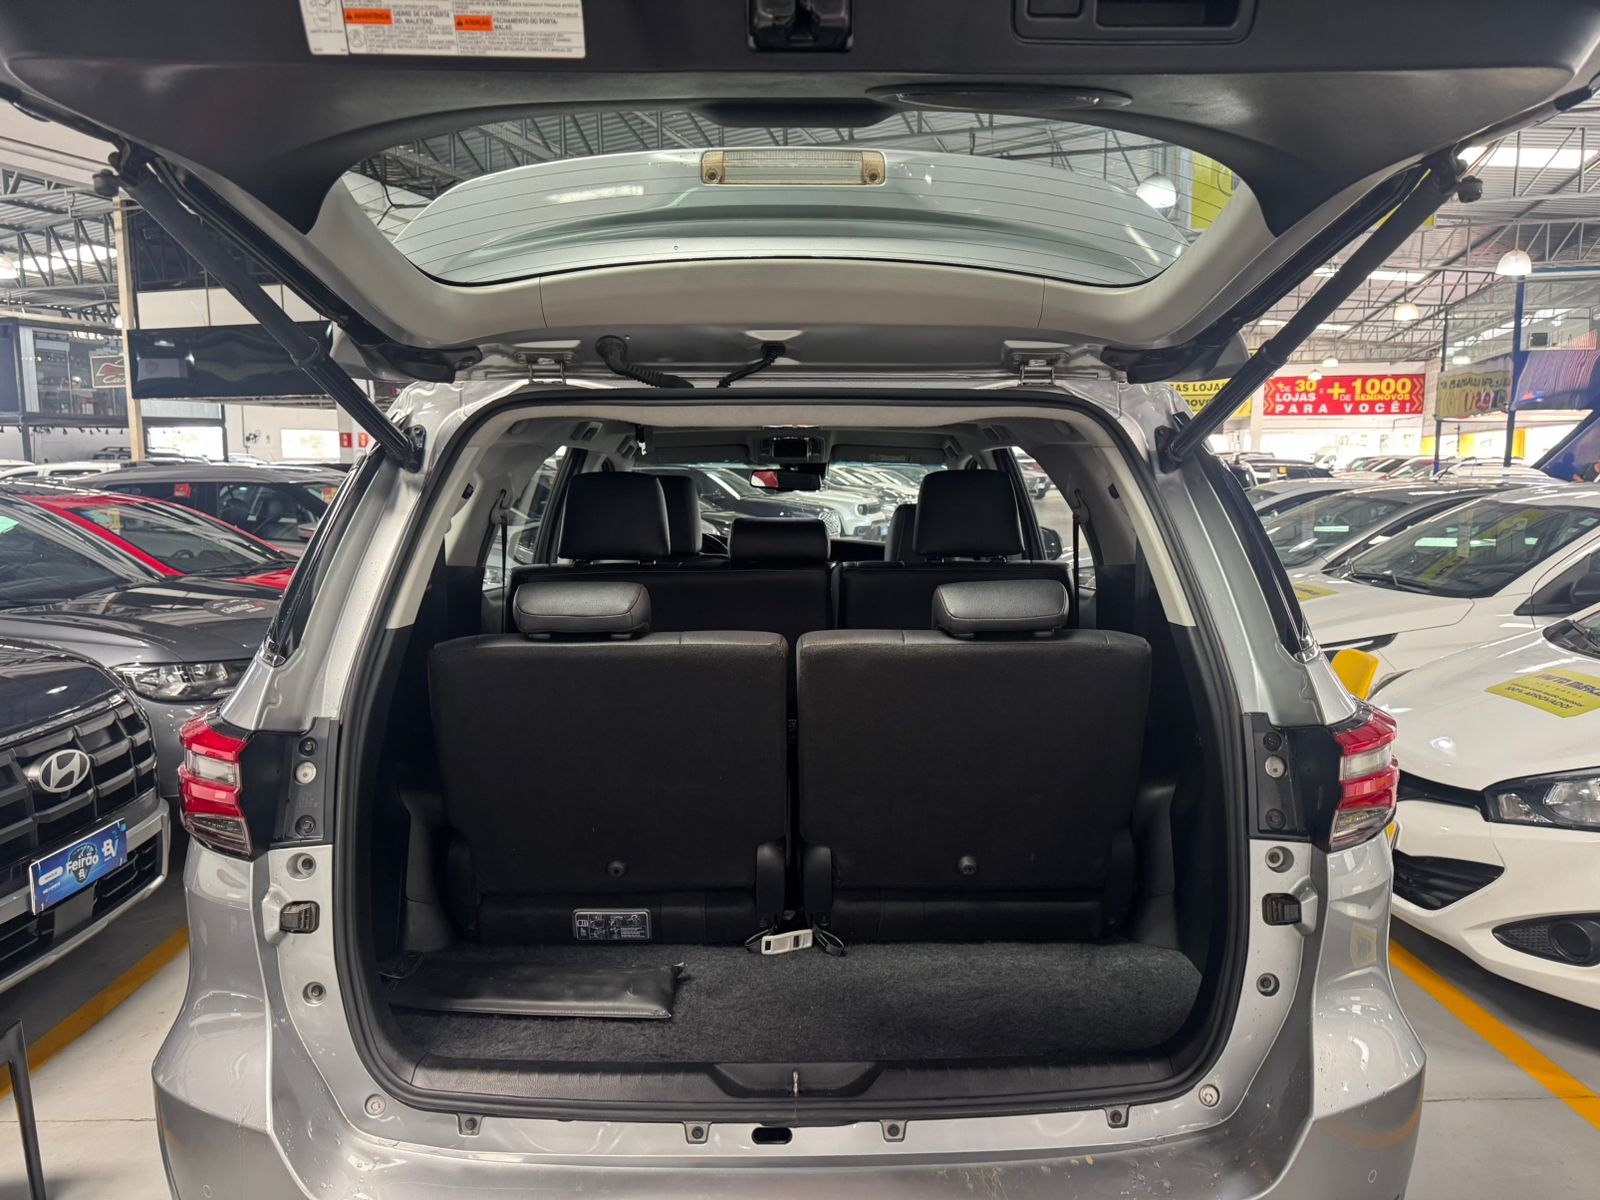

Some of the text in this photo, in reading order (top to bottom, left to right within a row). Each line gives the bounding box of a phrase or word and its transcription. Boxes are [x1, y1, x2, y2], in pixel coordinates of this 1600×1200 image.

[1295, 380, 1317, 393] 30
[1352, 378, 1412, 395] 1000
[1275, 392, 1317, 402] LOJAS
[1354, 392, 1411, 401] SEMINOVOS
[1275, 403, 1329, 414] PARA
[66, 852, 99, 878] Feirão
